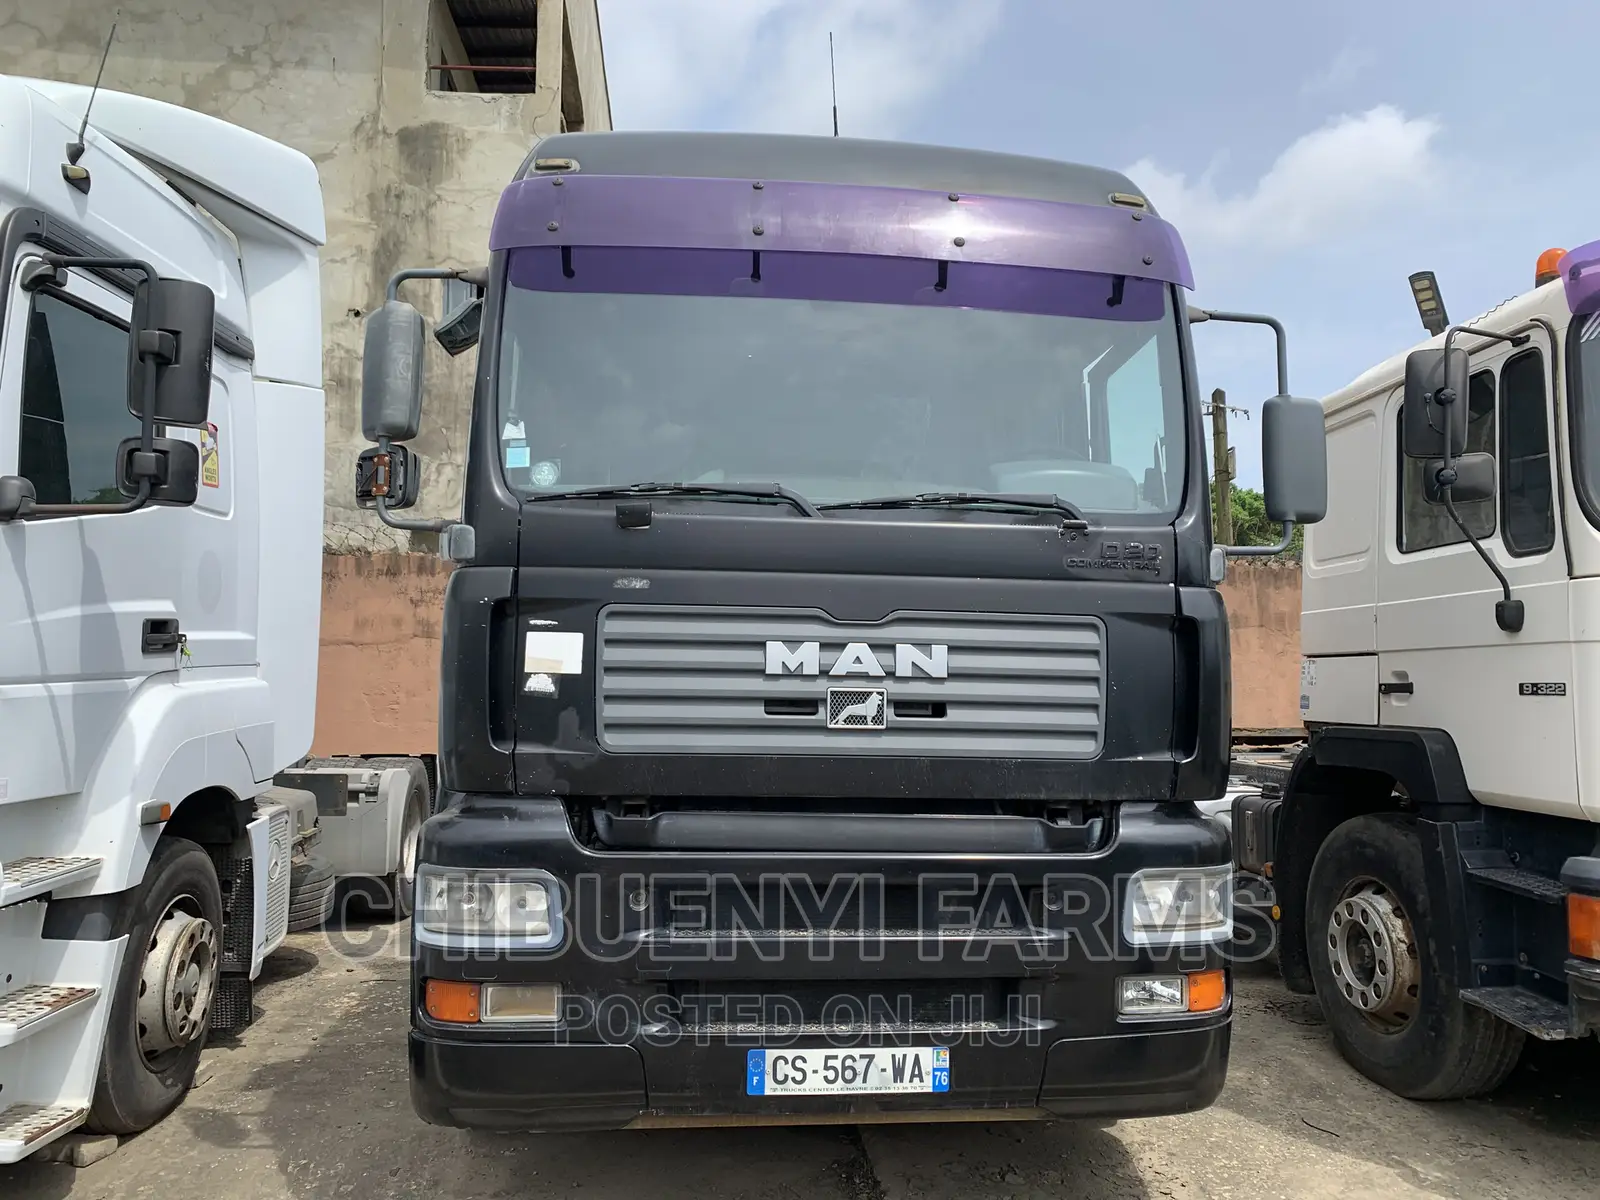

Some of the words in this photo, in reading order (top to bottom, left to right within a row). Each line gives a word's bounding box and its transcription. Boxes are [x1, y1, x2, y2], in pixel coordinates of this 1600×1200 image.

[765, 640, 948, 678] MAN
[772, 1053, 924, 1085] CS-567-WA
[934, 1071, 948, 1086] 76
[752, 1076, 759, 1086] F
